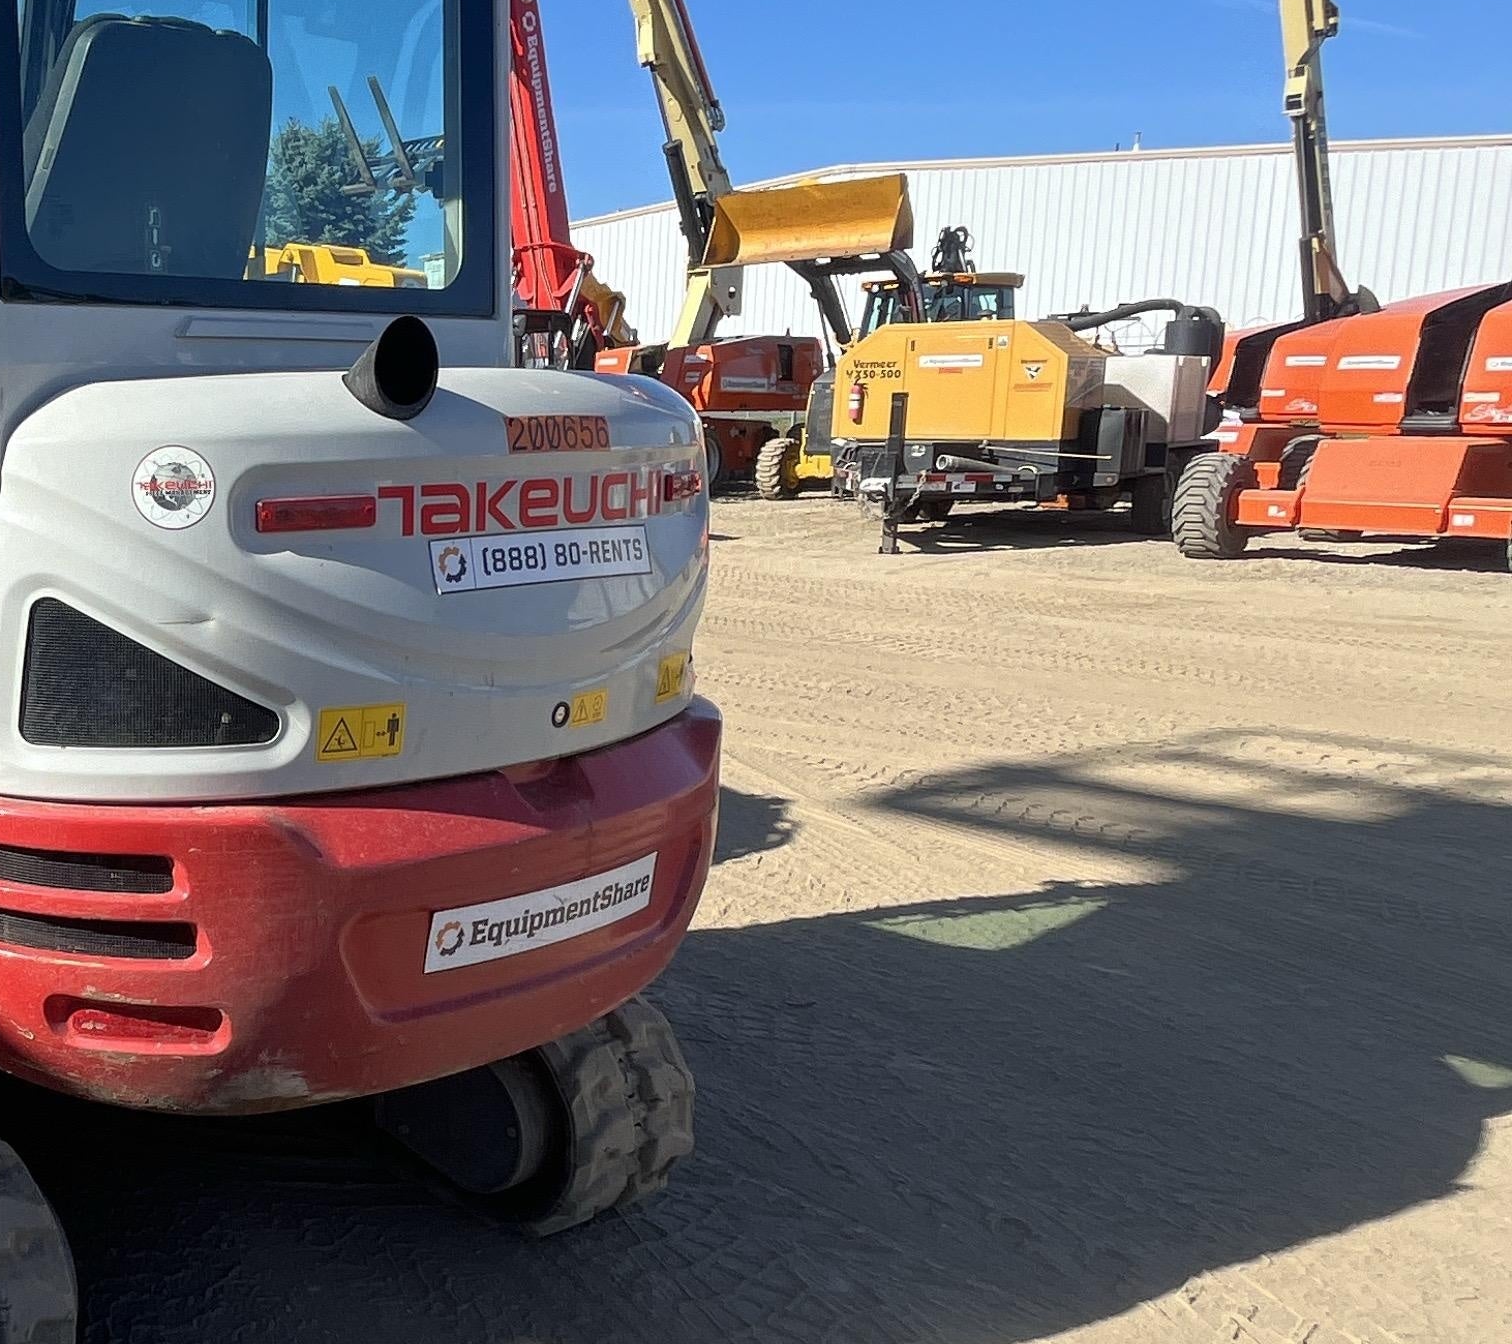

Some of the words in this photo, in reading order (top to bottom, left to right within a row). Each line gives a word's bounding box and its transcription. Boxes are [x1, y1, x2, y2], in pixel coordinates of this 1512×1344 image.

[527, 33, 558, 194] EquipmentShare
[510, 416, 610, 451] 200656
[377, 470, 662, 536] TAKEUCHI
[481, 544, 547, 576] (888)
[554, 538, 643, 567] 80-RENTS
[469, 874, 650, 946] EquipmentShare
